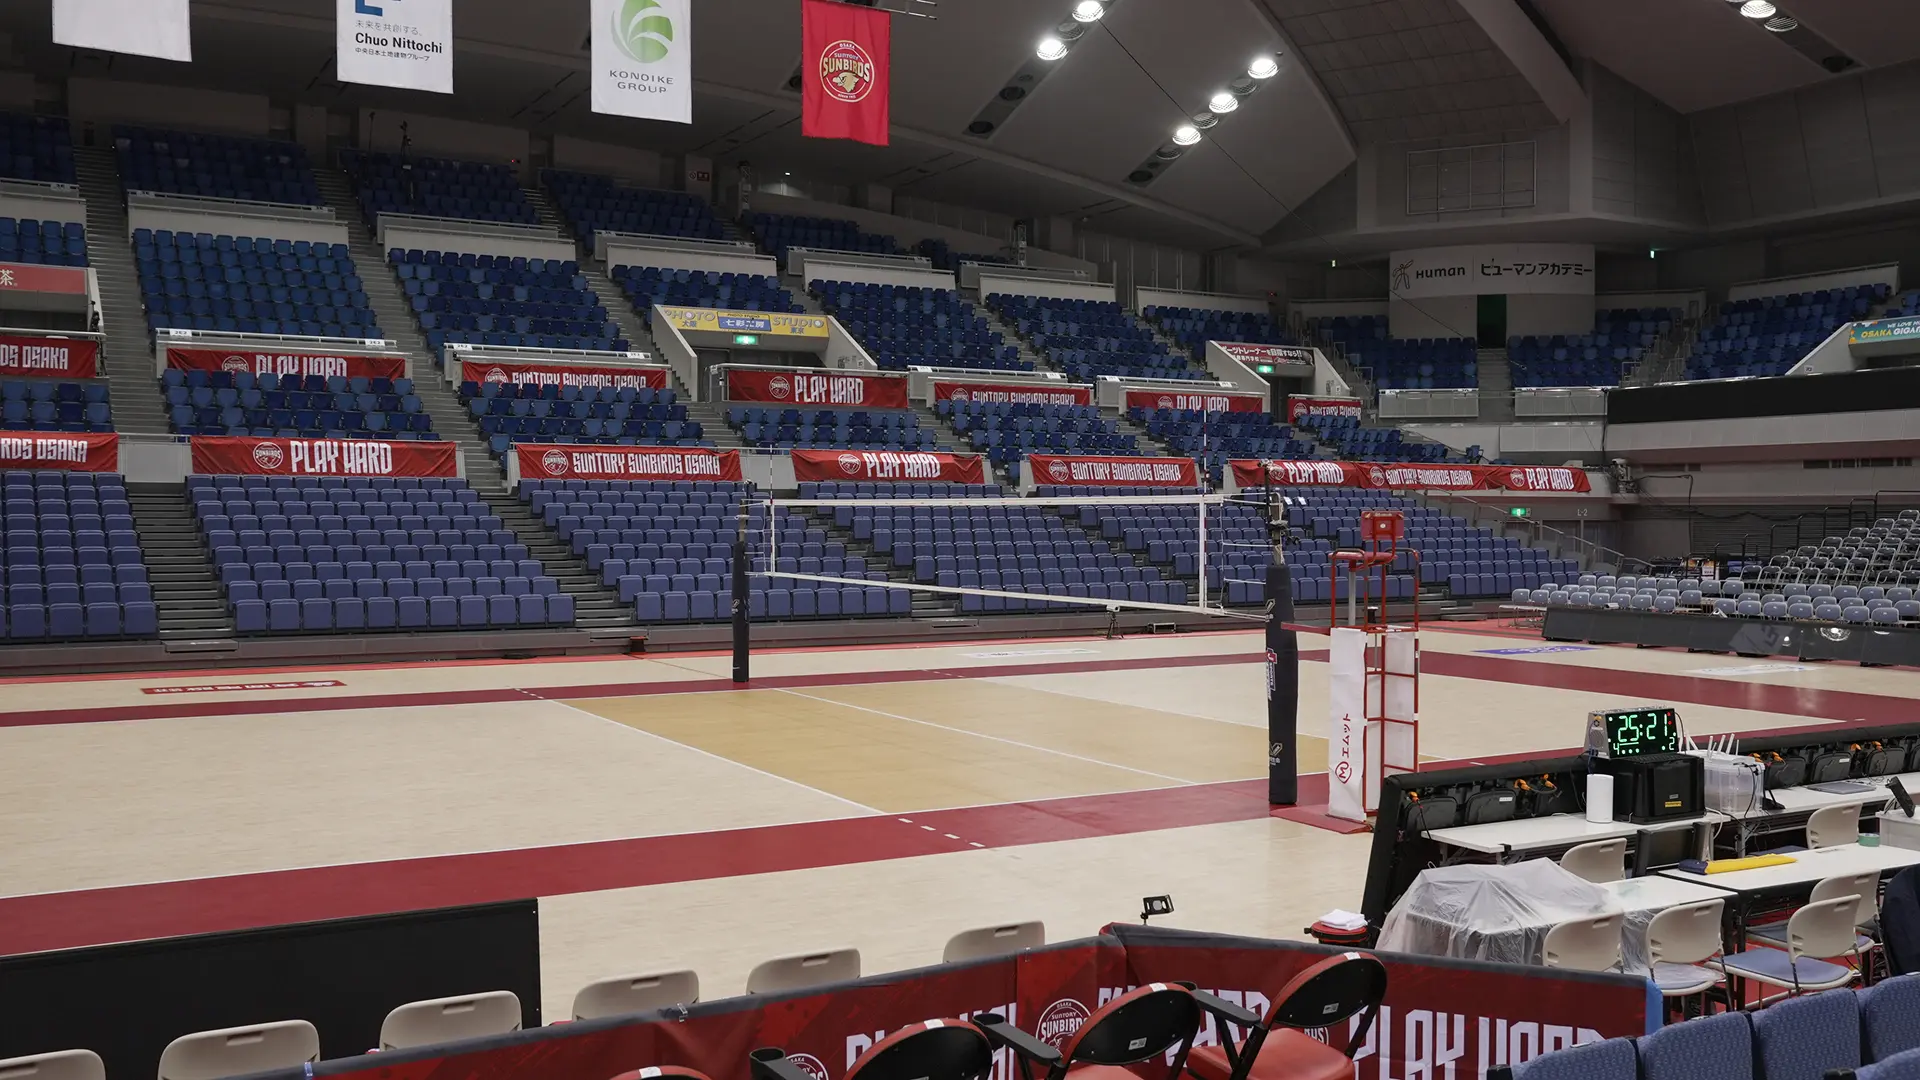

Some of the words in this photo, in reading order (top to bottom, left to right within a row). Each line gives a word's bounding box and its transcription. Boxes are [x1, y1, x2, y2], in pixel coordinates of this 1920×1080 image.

[355, 32, 388, 46] Chuo
[392, 37, 442, 53] Nittochi
[609, 69, 674, 85] KONOIKE
[823, 57, 870, 83] SUNBIRDS
[617, 81, 667, 93] GROUP
[772, 316, 824, 327] STUDIO
[1861, 330, 1892, 338] OSAKA
[22, 346, 69, 370] OSAKA
[255, 354, 300, 381] PLAY
[794, 375, 828, 402] PLAY
[830, 377, 864, 404] HARD
[37, 438, 88, 463] OSAKA
[290, 440, 339, 473] PLAY
[342, 441, 393, 474] HARD
[572, 452, 625, 474] SUNTORY
[628, 453, 683, 475] SUNBIRDS
[685, 454, 721, 475] OSAKA
[862, 452, 900, 478] PLAY
[901, 453, 941, 478] HARD
[1070, 462, 1110, 480] SUNTORY
[1112, 462, 1152, 481] SUNBIRDS
[1154, 463, 1181, 481] OSAKA
[1283, 461, 1314, 483] PLAY
[1313, 462, 1345, 484] HARD
[1385, 468, 1417, 485] SUNTORY
[1417, 469, 1450, 486] SUNBIRDS
[1450, 470, 1474, 486] OSAKA
[1525, 467, 1549, 490] PLAY
[1549, 468, 1575, 490] HARD
[1577, 508, 1588, 517] L-2
[1341, 713, 1351, 758] エムット
[1668, 736, 1675, 751] 2
[1613, 743, 1620, 755] 4
[1052, 1012, 1077, 1020] SUNTORY
[1041, 1018, 1088, 1043] SUNBIRD
[1350, 1004, 1465, 1080] PLAY
